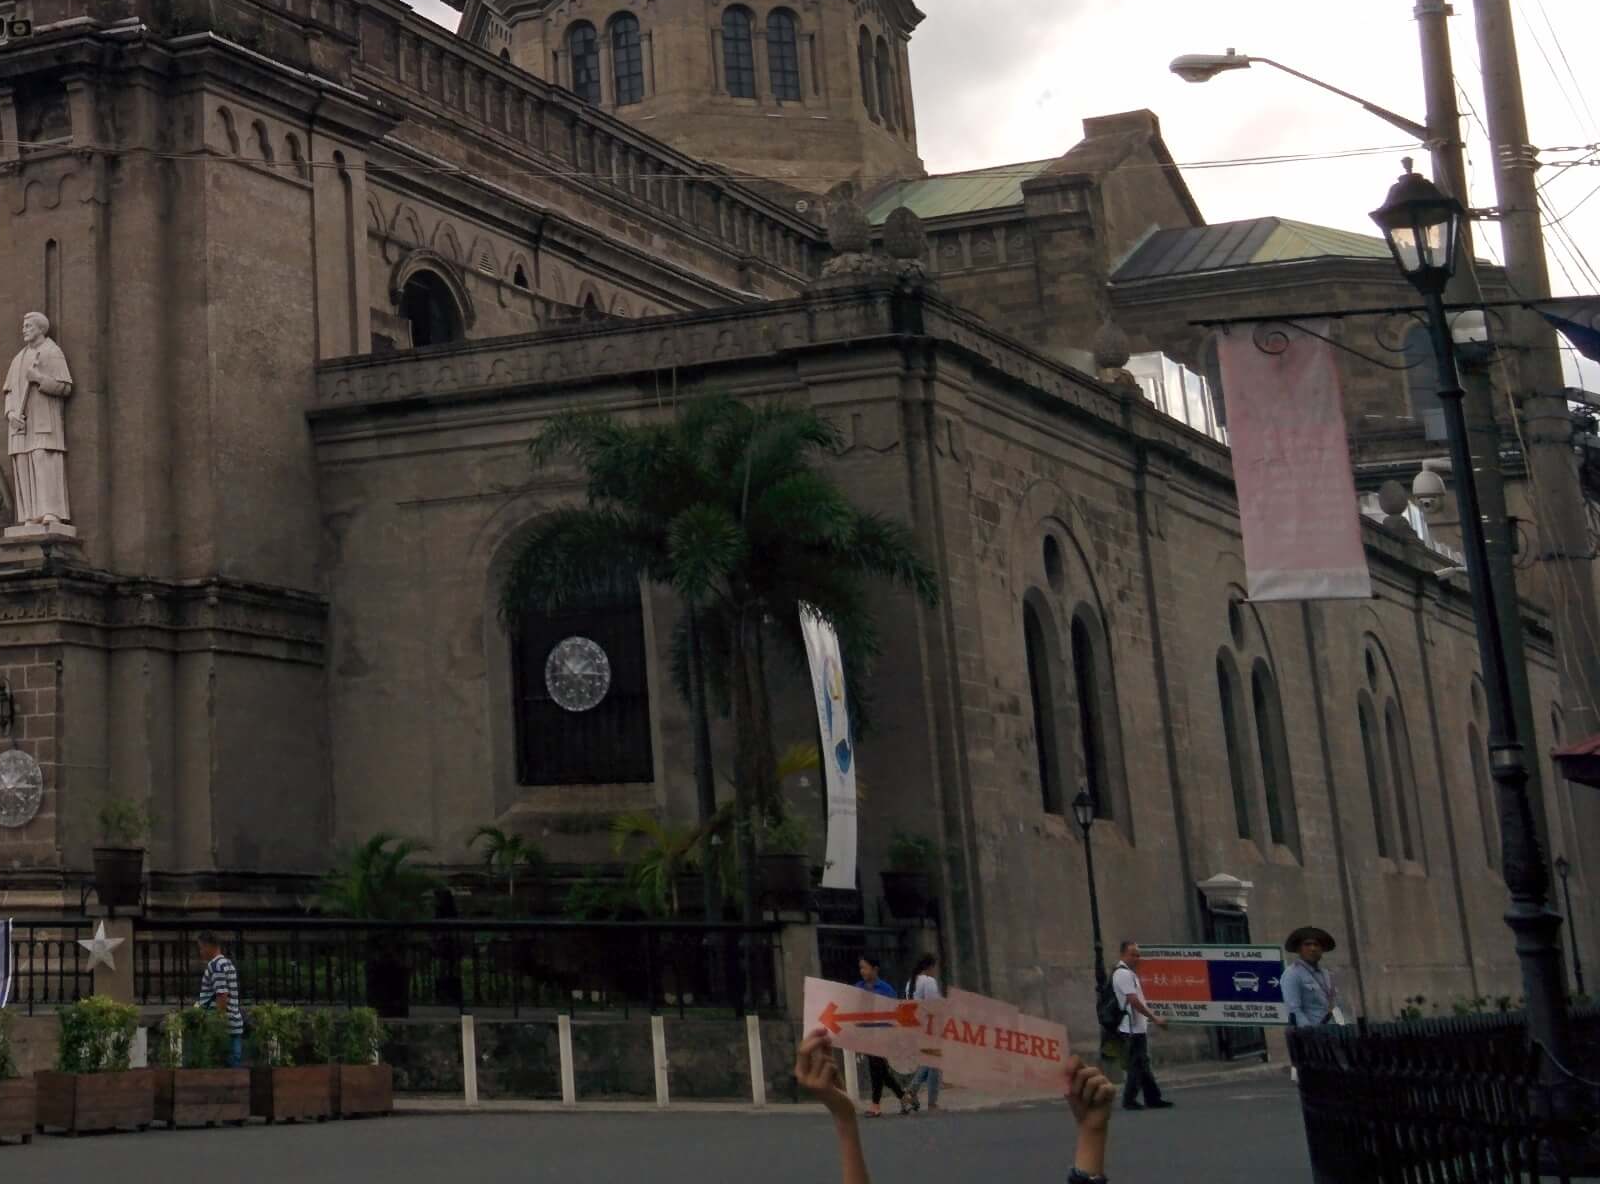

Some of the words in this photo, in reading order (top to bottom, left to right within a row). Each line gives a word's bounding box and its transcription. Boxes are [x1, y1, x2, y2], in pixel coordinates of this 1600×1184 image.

[1183, 950, 1202, 958] LANE
[1241, 951, 1263, 959] LANE
[925, 1013, 935, 1036] I
[941, 1017, 987, 1047] AM
[994, 1027, 1061, 1062] HERE
